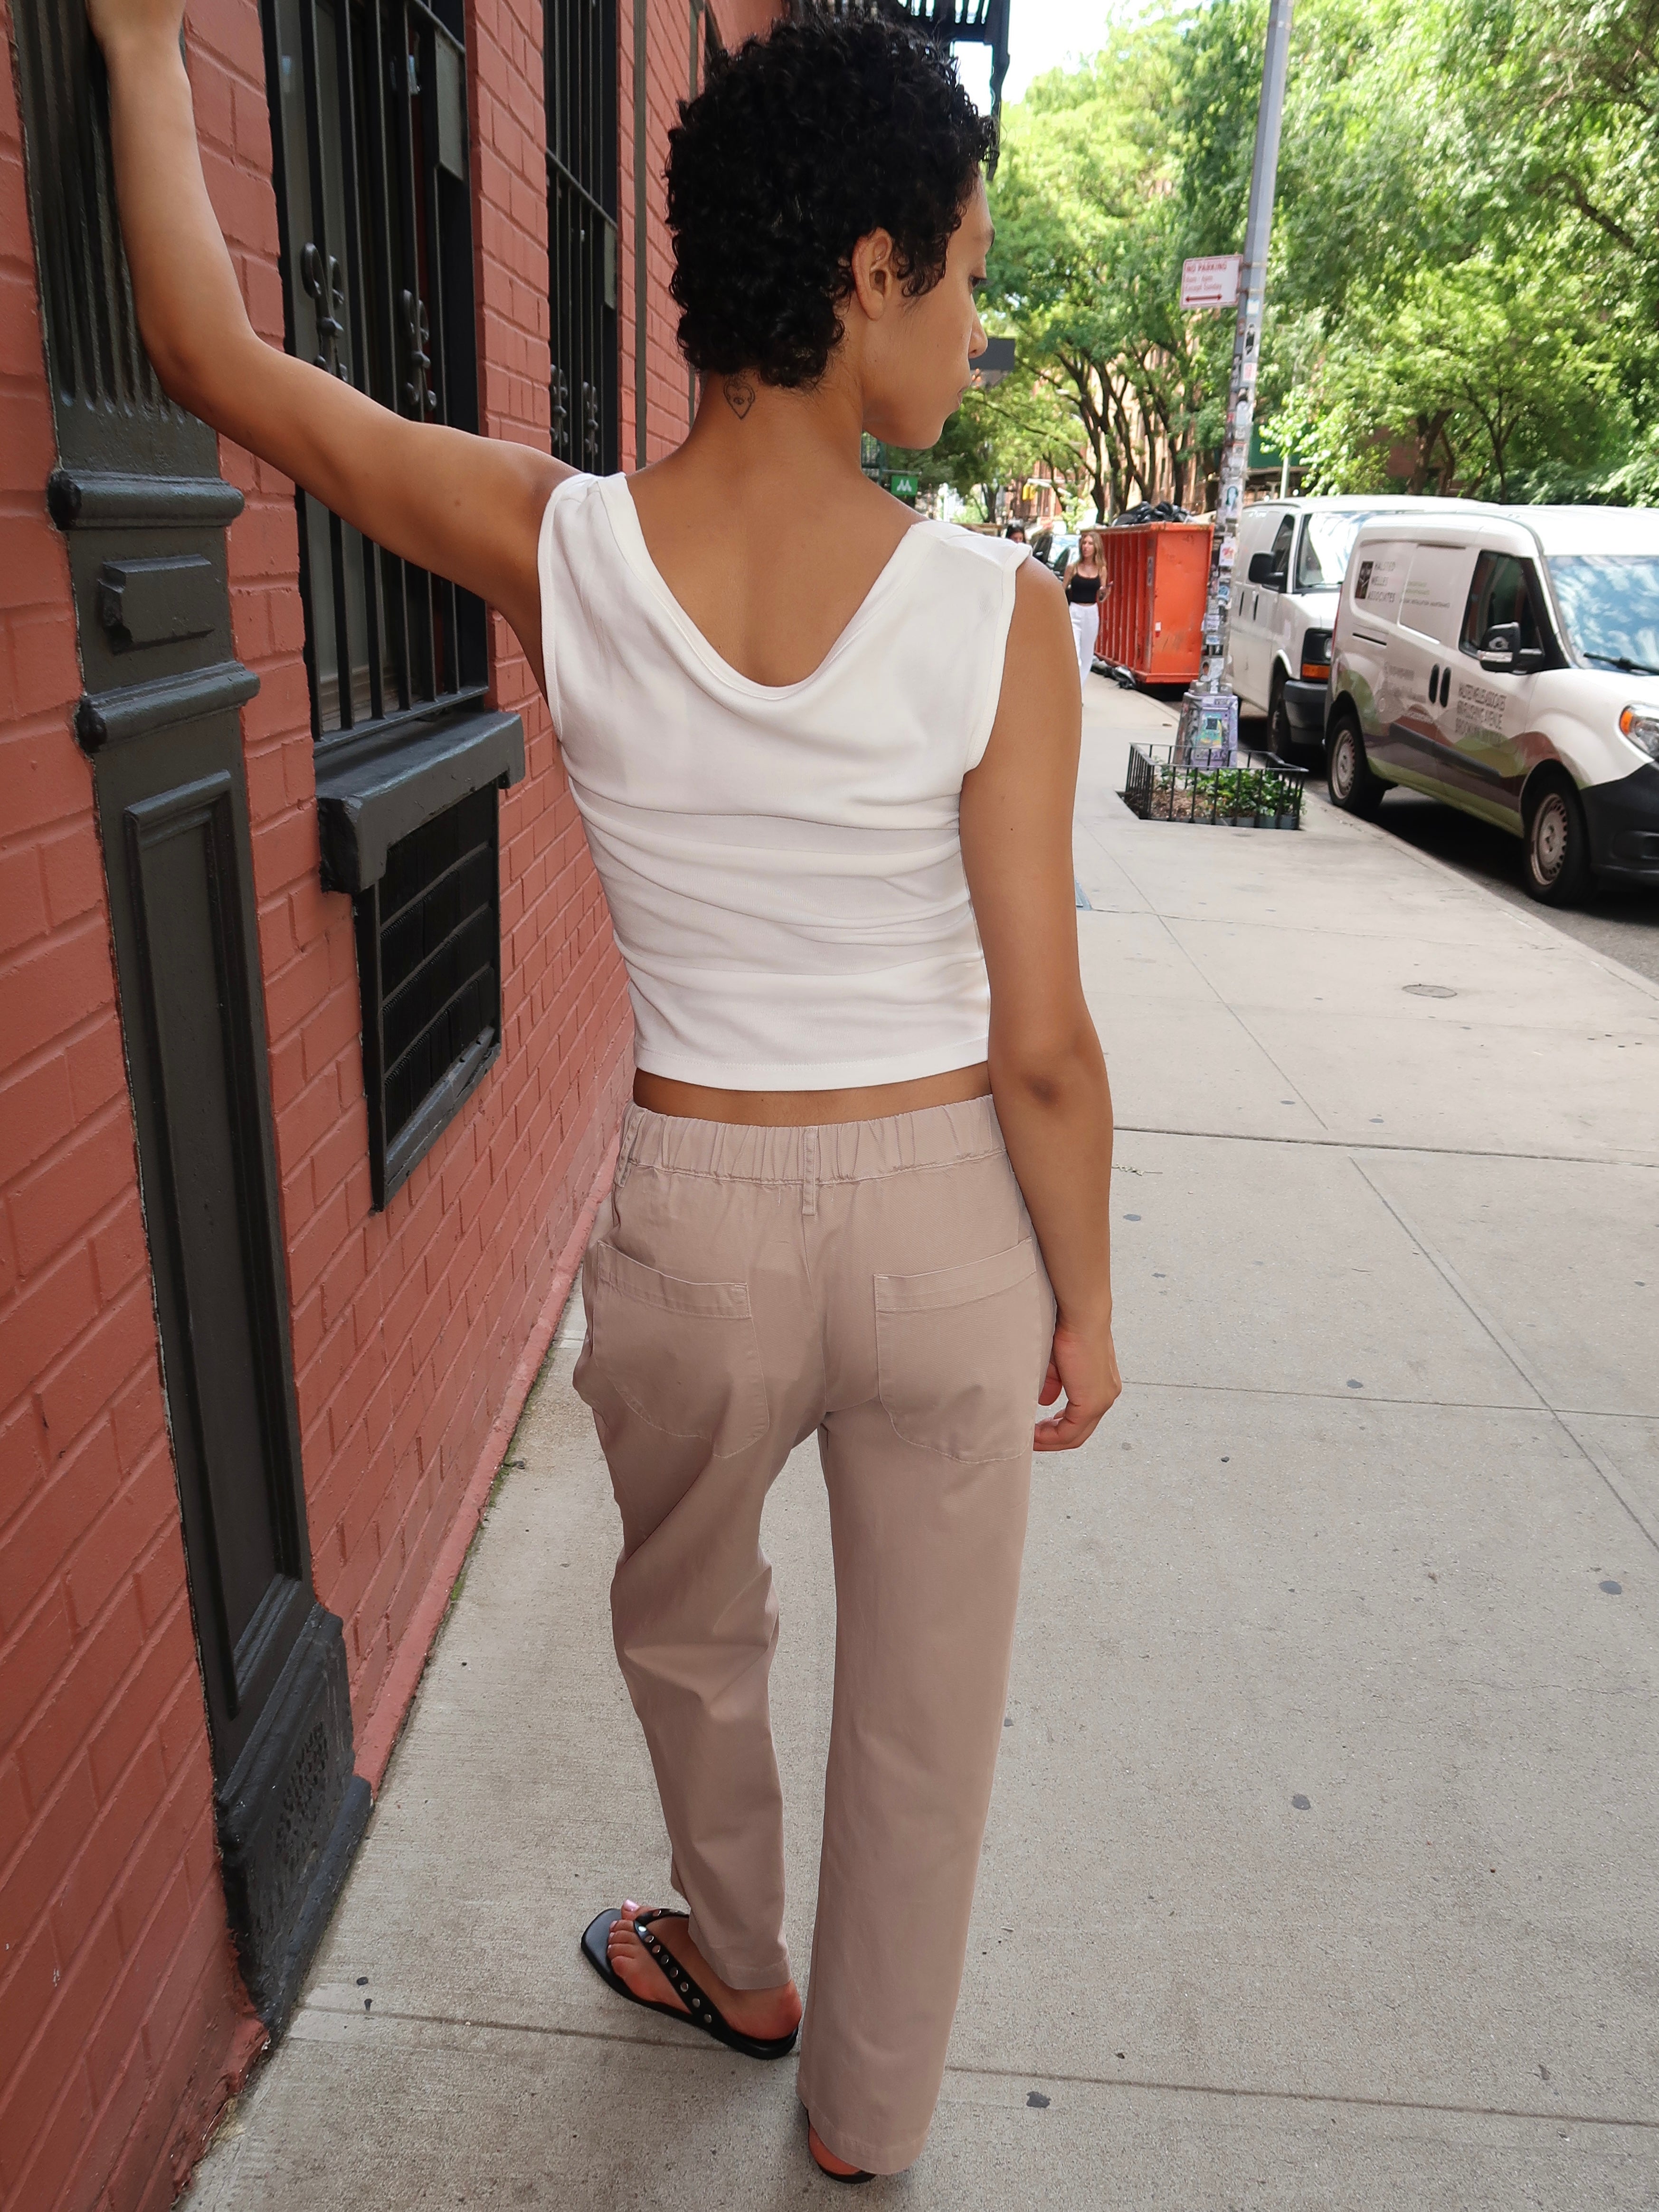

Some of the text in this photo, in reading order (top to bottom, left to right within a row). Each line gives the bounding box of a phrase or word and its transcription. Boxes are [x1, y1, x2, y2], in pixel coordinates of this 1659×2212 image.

[1185, 262, 1227, 272] NO PARKING
[1367, 591, 1396, 602] ASSOCIATES
